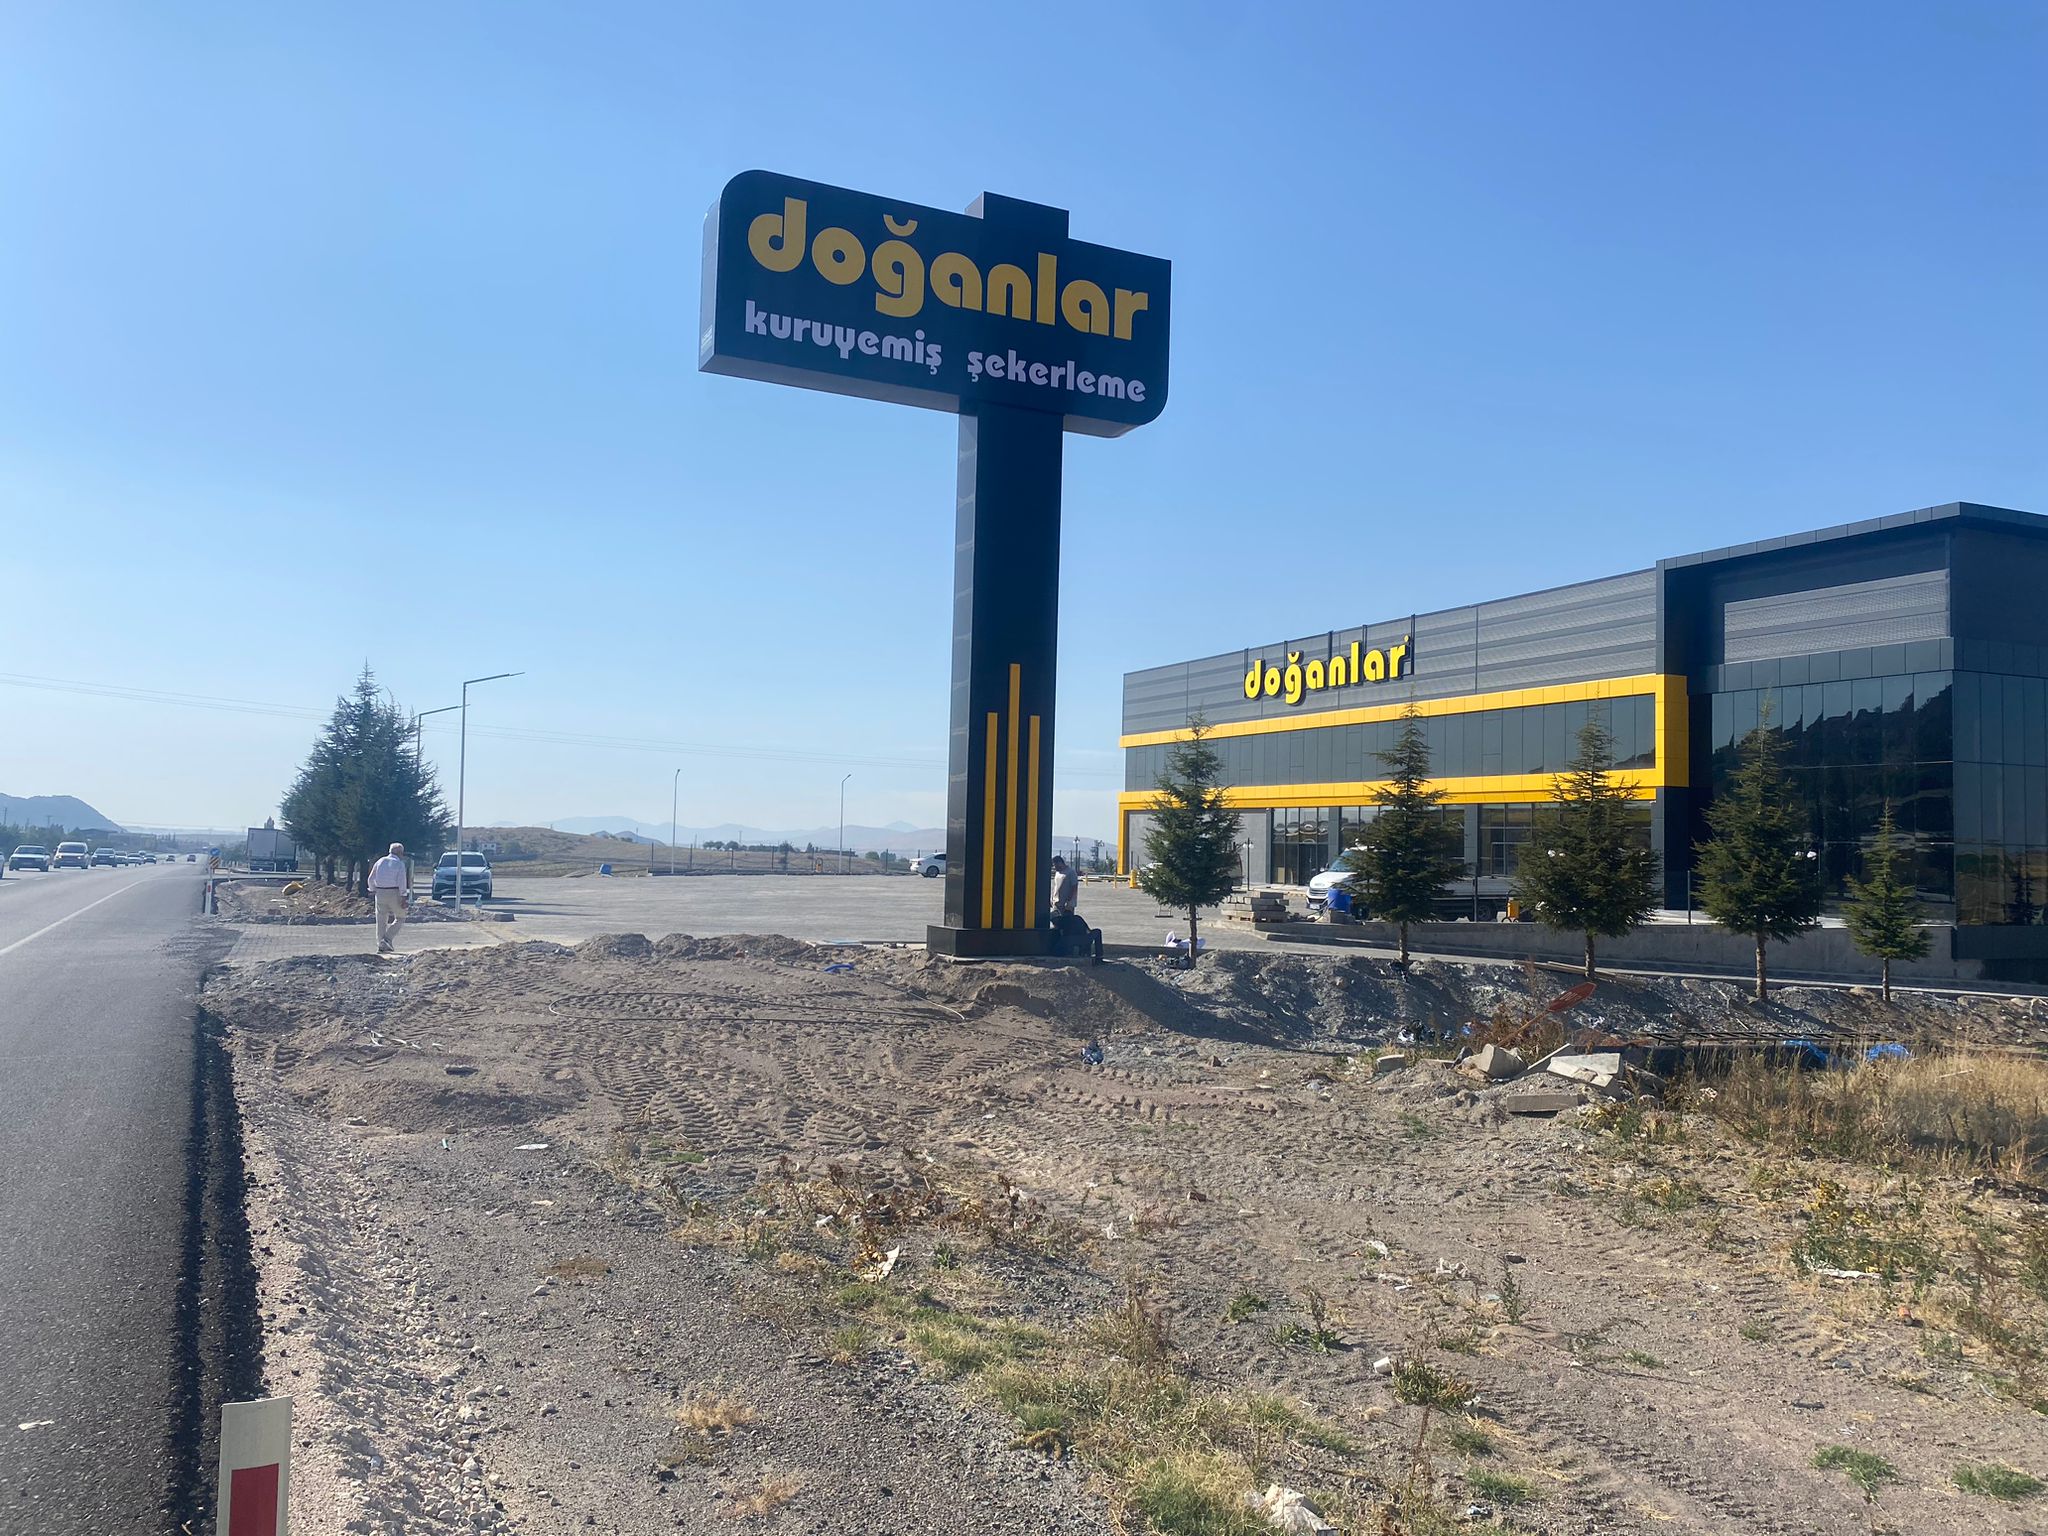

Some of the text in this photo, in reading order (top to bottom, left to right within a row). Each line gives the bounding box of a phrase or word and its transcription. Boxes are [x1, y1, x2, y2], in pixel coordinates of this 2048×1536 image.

[747, 196, 1150, 341] doğanlar
[744, 299, 1147, 403] kuruyemiş şekerleme
[1243, 639, 1408, 706] doğanlar
